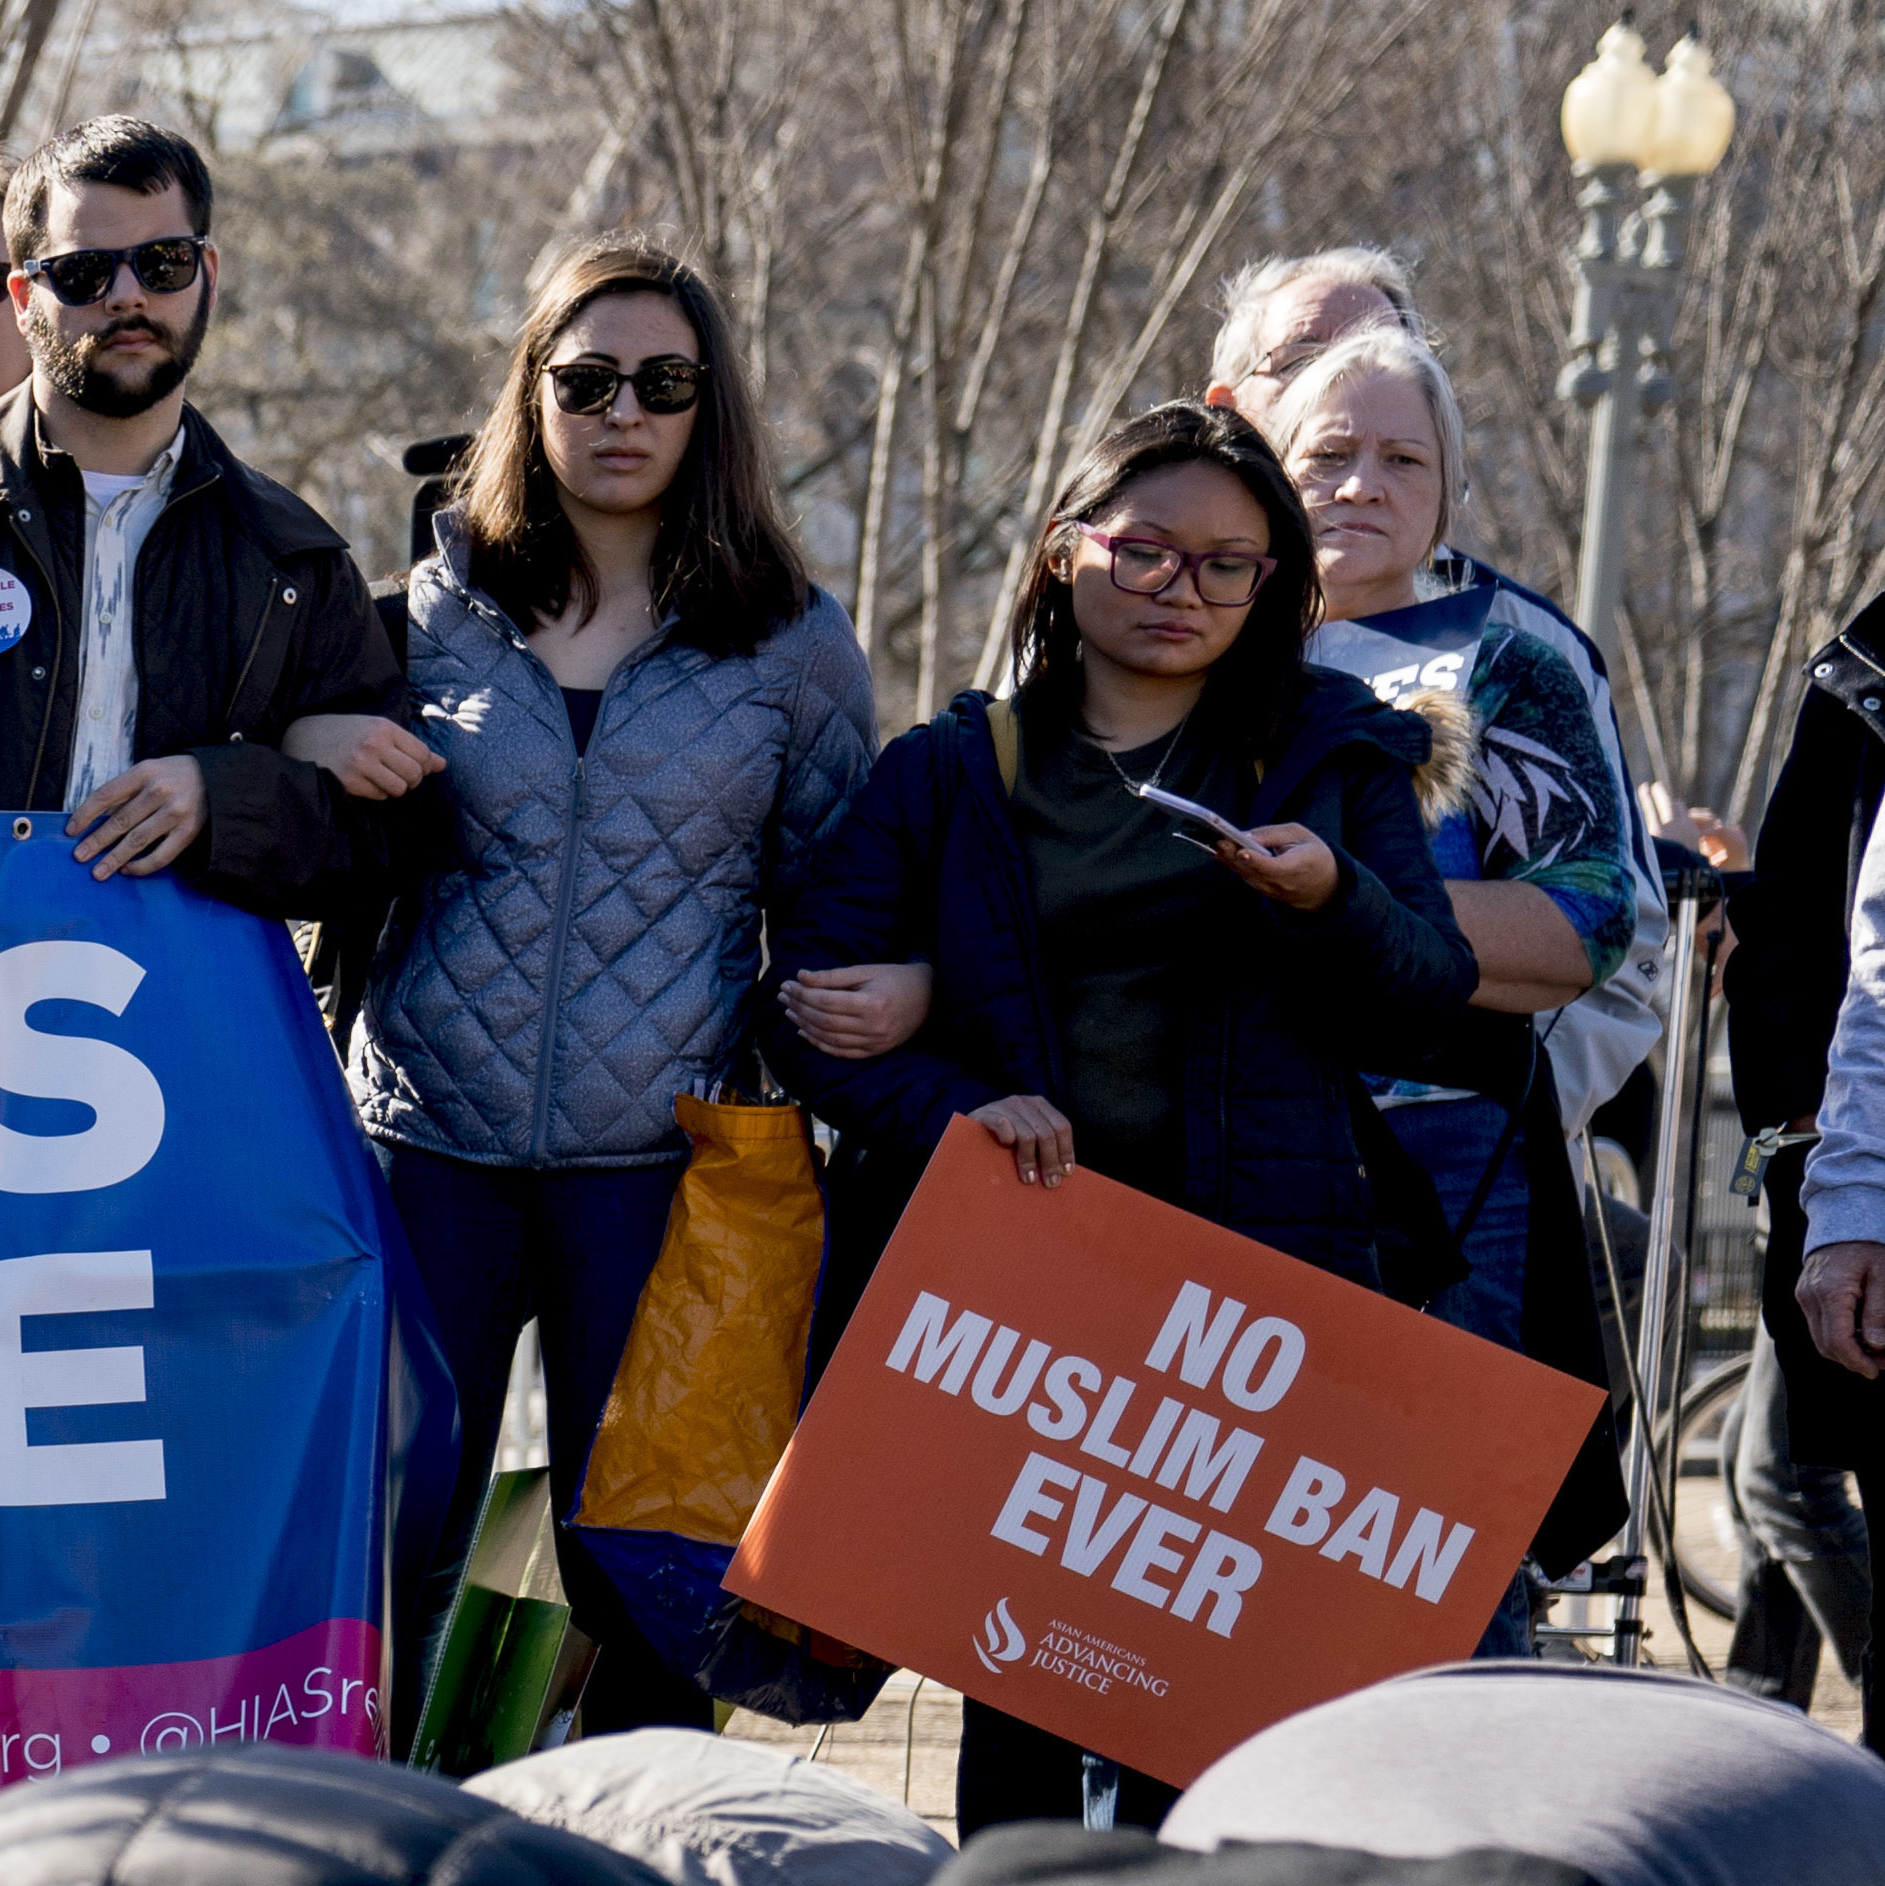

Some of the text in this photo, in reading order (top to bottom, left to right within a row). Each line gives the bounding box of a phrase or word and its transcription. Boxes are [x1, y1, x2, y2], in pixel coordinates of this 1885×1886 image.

[1363, 652, 1465, 712] ES
[1144, 1280, 1306, 1412] NO
[886, 1291, 1475, 1605] MUSLIM BAN
[990, 1452, 1263, 1639] EVER
[1028, 1649, 1113, 1695] JUSTICE
[1040, 1631, 1169, 1697] ADVANCING
[1049, 1619, 1147, 1667] ASIAN AMERICANS
